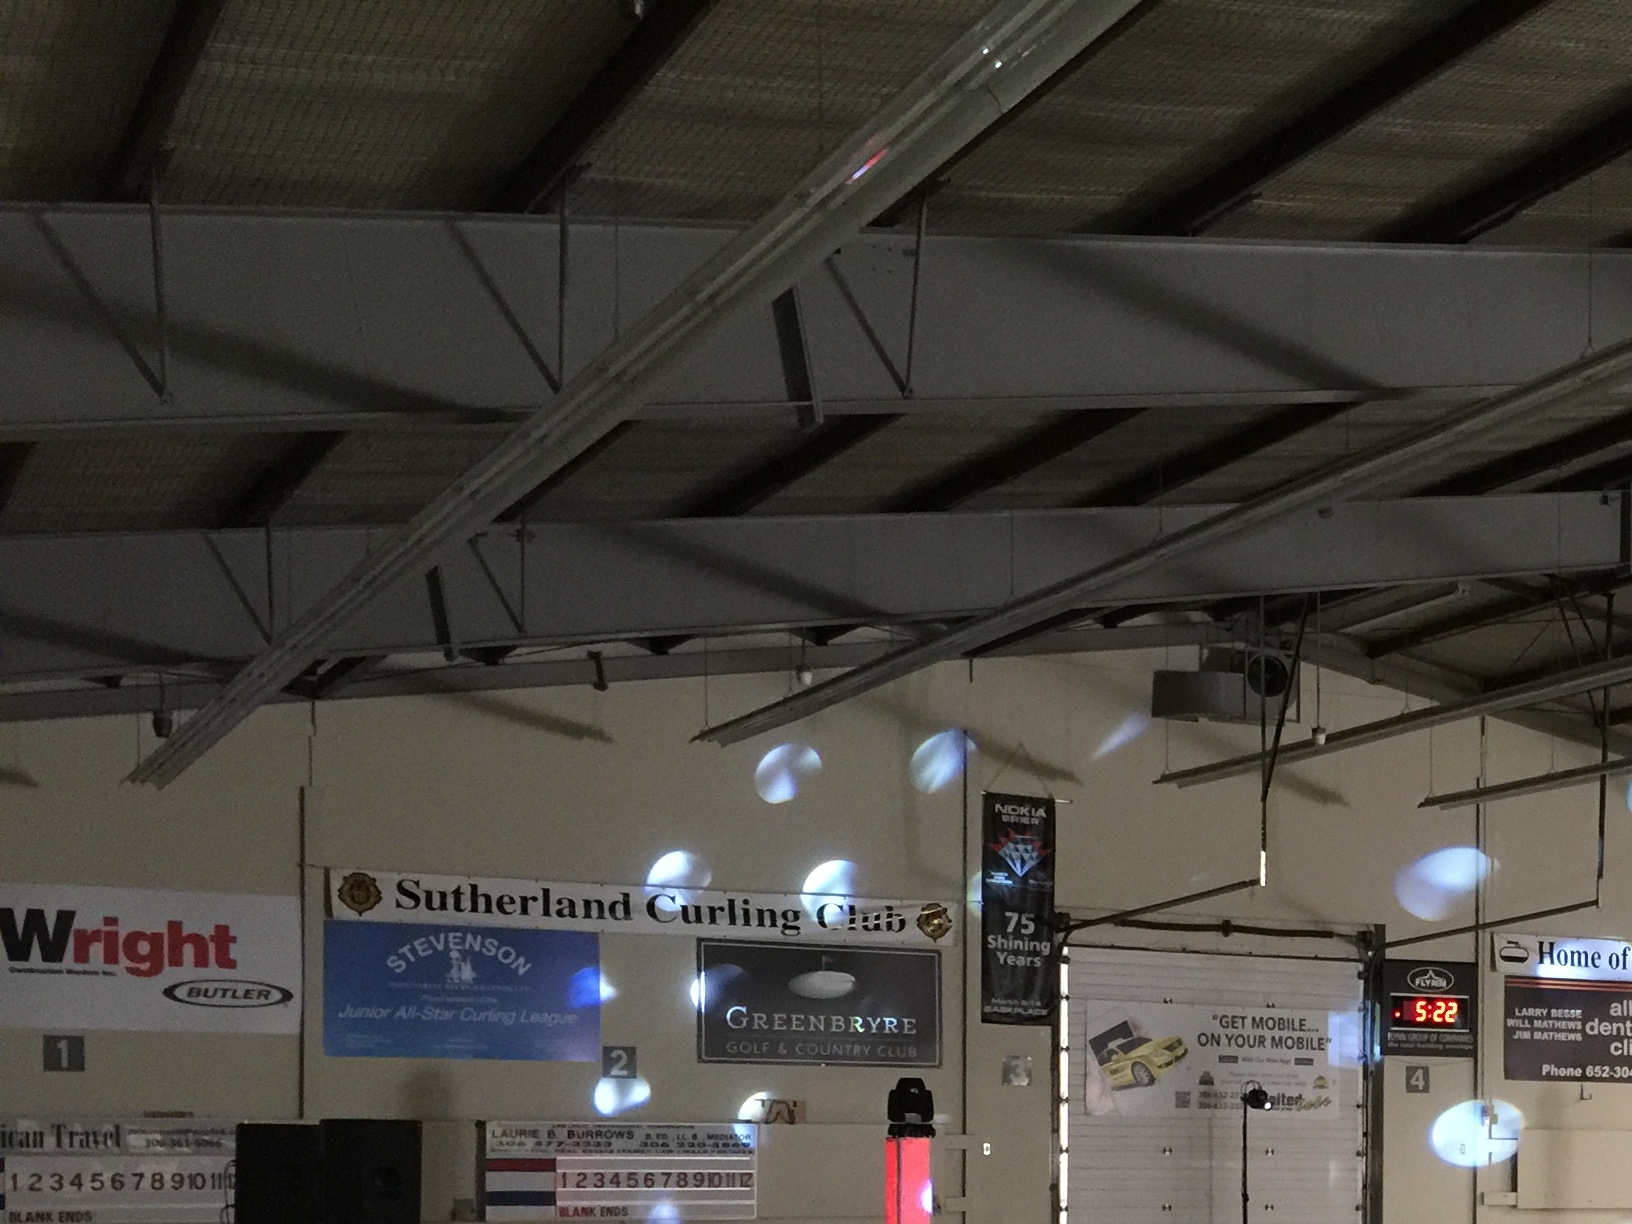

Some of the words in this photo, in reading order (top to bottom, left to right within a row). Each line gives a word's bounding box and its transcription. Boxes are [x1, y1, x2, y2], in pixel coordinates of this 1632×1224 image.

[995, 804, 1047, 819] NOKIA
[395, 878, 633, 921] Sutherland
[646, 893, 802, 937] Curling
[816, 902, 907, 934] Club
[1004, 911, 1036, 935] 75
[0, 907, 237, 977] Wright
[986, 934, 1051, 955] Shining
[386, 932, 532, 976] STEVENSON
[997, 950, 1042, 968] Years
[1537, 941, 1601, 968] Home
[1608, 946, 1632, 969] of
[1415, 977, 1447, 988] FLYNN
[186, 986, 273, 1001] BUTLER
[338, 1005, 391, 1019] Junior
[393, 1005, 454, 1022] All-Star
[459, 1008, 516, 1025] Curling
[520, 1010, 578, 1028] League
[726, 1005, 917, 1035] GREENBRYRE
[1415, 1001, 1458, 1023] 5:22
[1515, 1007, 1548, 1018] LARRY
[1551, 1009, 1582, 1019] BESSE
[1506, 1018, 1531, 1028] WILL
[1533, 1019, 1582, 1030] MATHEWS
[1197, 1032, 1221, 1047] ON
[1225, 1033, 1266, 1049] YOUR
[1512, 1030, 1531, 1040] JIM
[1533, 1031, 1582, 1042] MATHEWS
[57, 1038, 69, 1069] 1
[726, 1041, 770, 1056] GOLF
[779, 1042, 788, 1056] &
[795, 1043, 871, 1059] COUNTRY
[877, 1044, 918, 1060] CLUB
[610, 1049, 629, 1076] 2
[1541, 1064, 1582, 1078] Phone
[1410, 1068, 1426, 1091] 4
[1267, 1093, 1302, 1107] nited
[51, 1124, 121, 1149] Travel
[491, 1129, 540, 1139] LAURIE
[567, 1130, 634, 1140] BURROWS
[706, 1133, 751, 1141] MEDIATOR
[10, 1173, 18, 1191] 1
[28, 1173, 43, 1191] 2
[50, 1173, 64, 1191] 3
[69, 1173, 84, 1191] 4
[90, 1173, 105, 1191] 5
[111, 1173, 125, 1191] 6
[132, 1173, 145, 1191] 7
[151, 1173, 165, 1191] 8
[170, 1173, 184, 1191] 9
[188, 1173, 206, 1191] 10
[211, 1173, 222, 1191] 11
[561, 1172, 567, 1188] 1
[576, 1172, 587, 1188] 2
[593, 1172, 605, 1188] 3
[609, 1172, 621, 1188] 4
[627, 1172, 638, 1188] 5
[643, 1172, 655, 1188] 6
[661, 1172, 672, 1188] 7
[676, 1172, 688, 1188] 8
[693, 1172, 705, 1188] 9
[707, 1172, 722, 1188] 10
[725, 1172, 737, 1188] 11
[739, 1172, 753, 1188] 12
[9, 1210, 53, 1224] BLANK
[59, 1210, 93, 1224] ENDS
[559, 1206, 596, 1218] BLANK
[600, 1206, 629, 1218] ENDS
